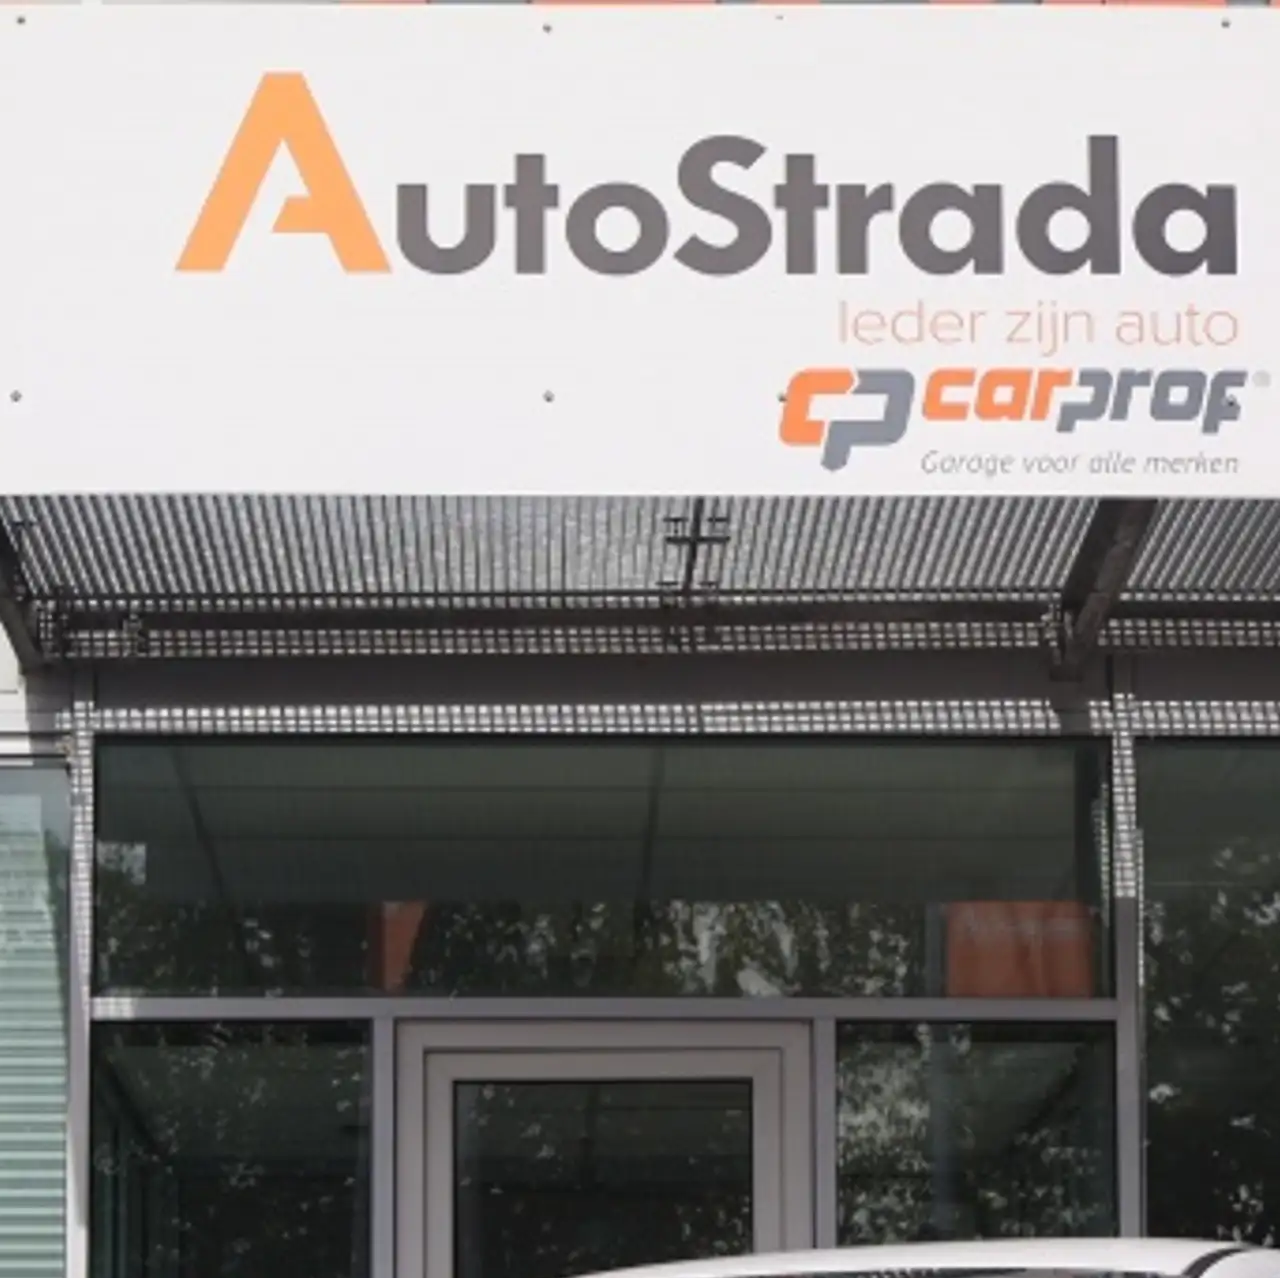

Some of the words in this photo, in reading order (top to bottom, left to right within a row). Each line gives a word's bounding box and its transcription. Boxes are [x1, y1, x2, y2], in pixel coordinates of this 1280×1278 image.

[174, 71, 1238, 277] AutoStrada
[837, 300, 984, 346] Ieder
[1005, 300, 1096, 357] zijn
[1115, 305, 1239, 346] auto
[921, 366, 1249, 434] carprof
[920, 450, 1015, 478] Garage
[1022, 453, 1079, 475] voor
[1088, 450, 1136, 475] alle
[1142, 450, 1239, 475] merken
